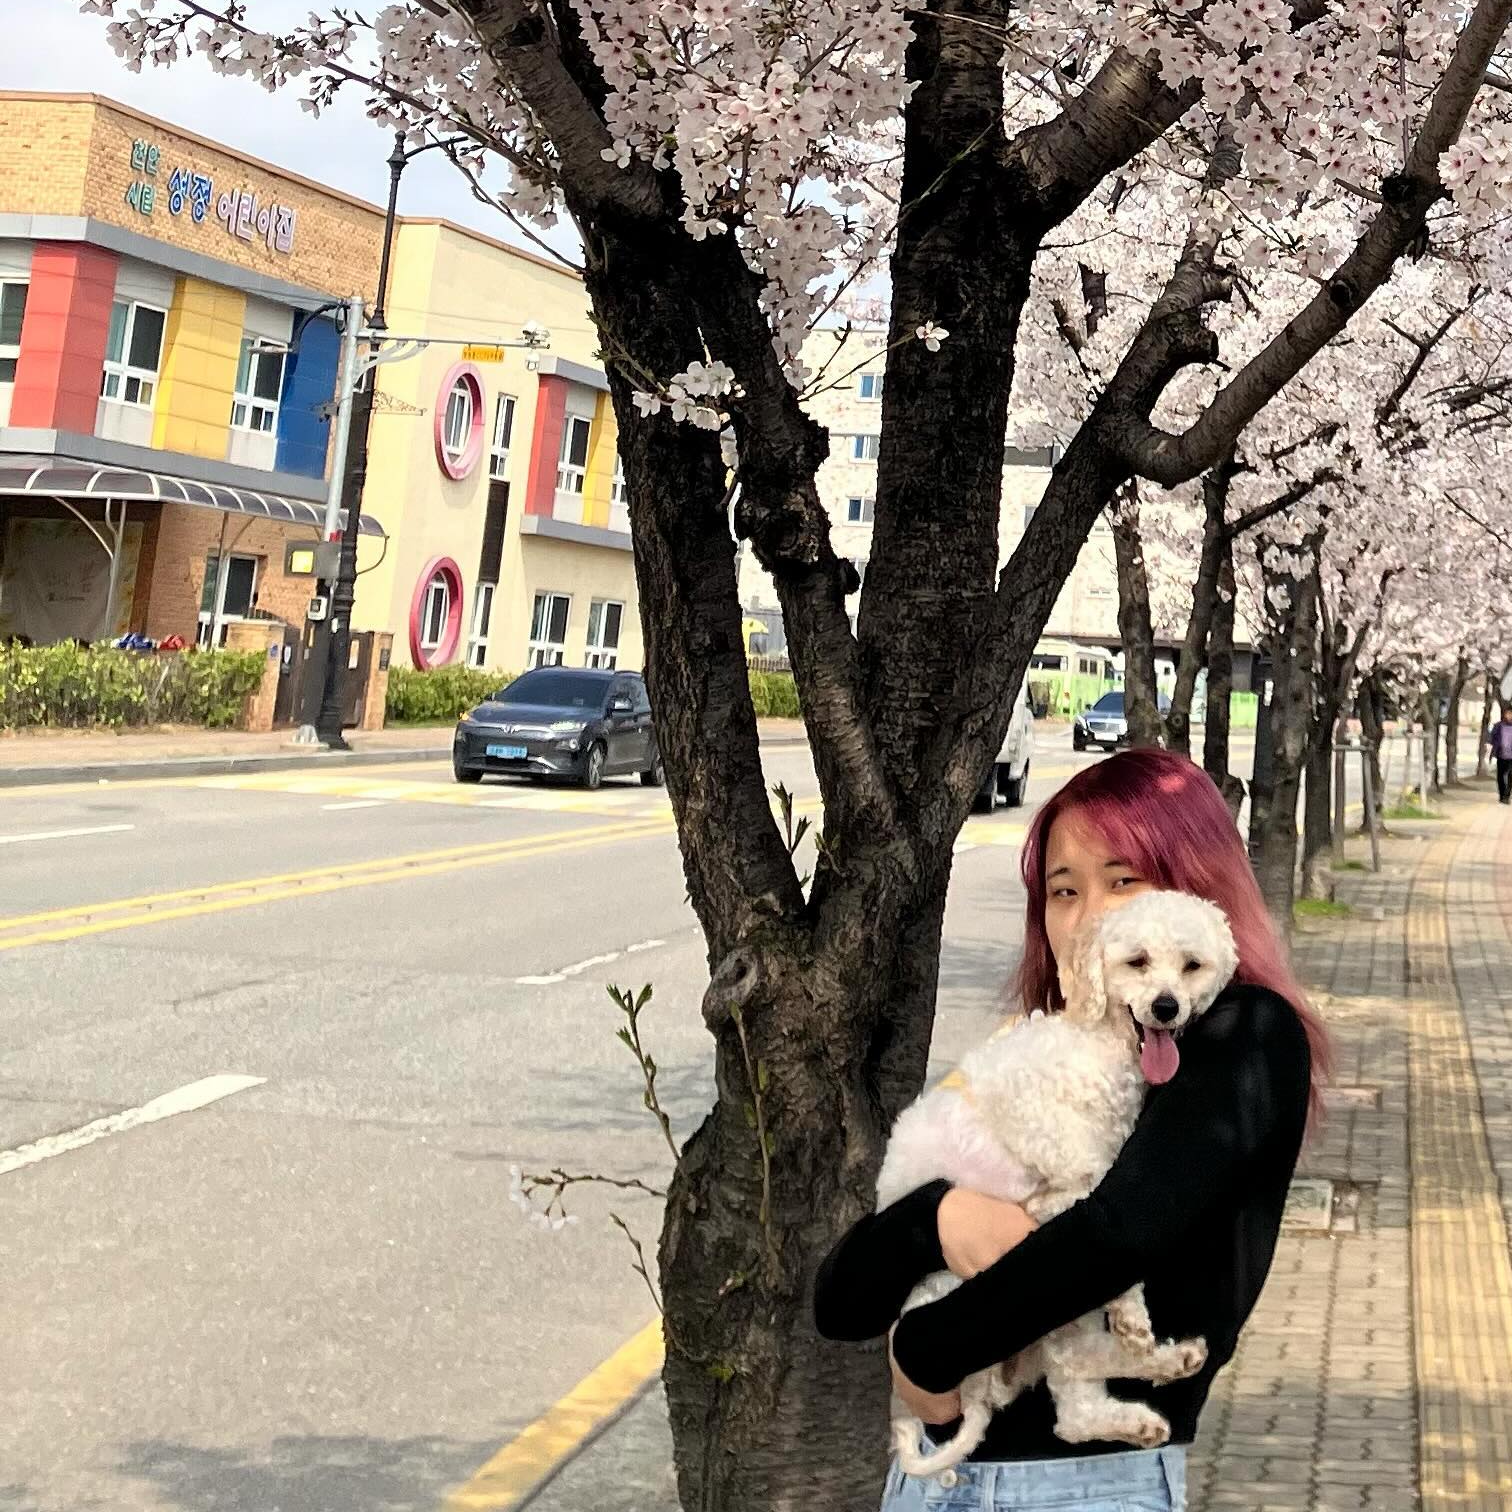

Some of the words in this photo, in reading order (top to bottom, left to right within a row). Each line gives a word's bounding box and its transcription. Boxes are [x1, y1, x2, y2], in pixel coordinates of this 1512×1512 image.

[130, 138, 160, 174] 천안
[125, 181, 157, 217] 시립
[168, 167, 214, 224] 성정
[216, 188, 297, 254] 어린이집
